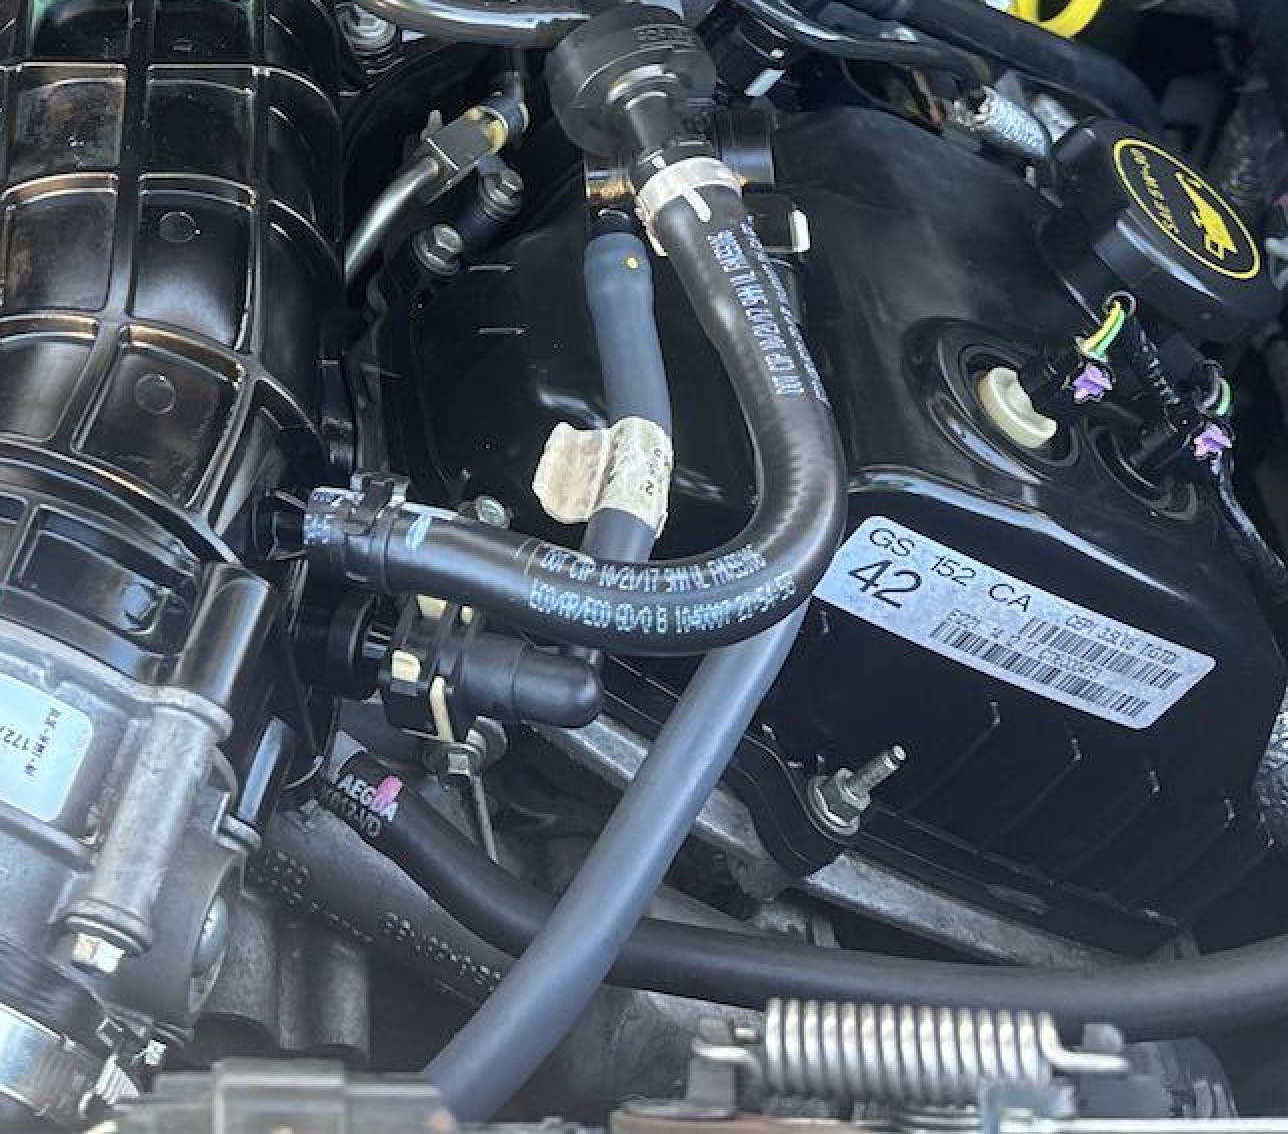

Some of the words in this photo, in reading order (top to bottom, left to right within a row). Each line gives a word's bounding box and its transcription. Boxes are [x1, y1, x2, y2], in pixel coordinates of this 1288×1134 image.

[848, 559, 923, 609] 42
[869, 527, 915, 557] GS
[931, 555, 977, 587] 152
[989, 583, 1031, 613] CA
